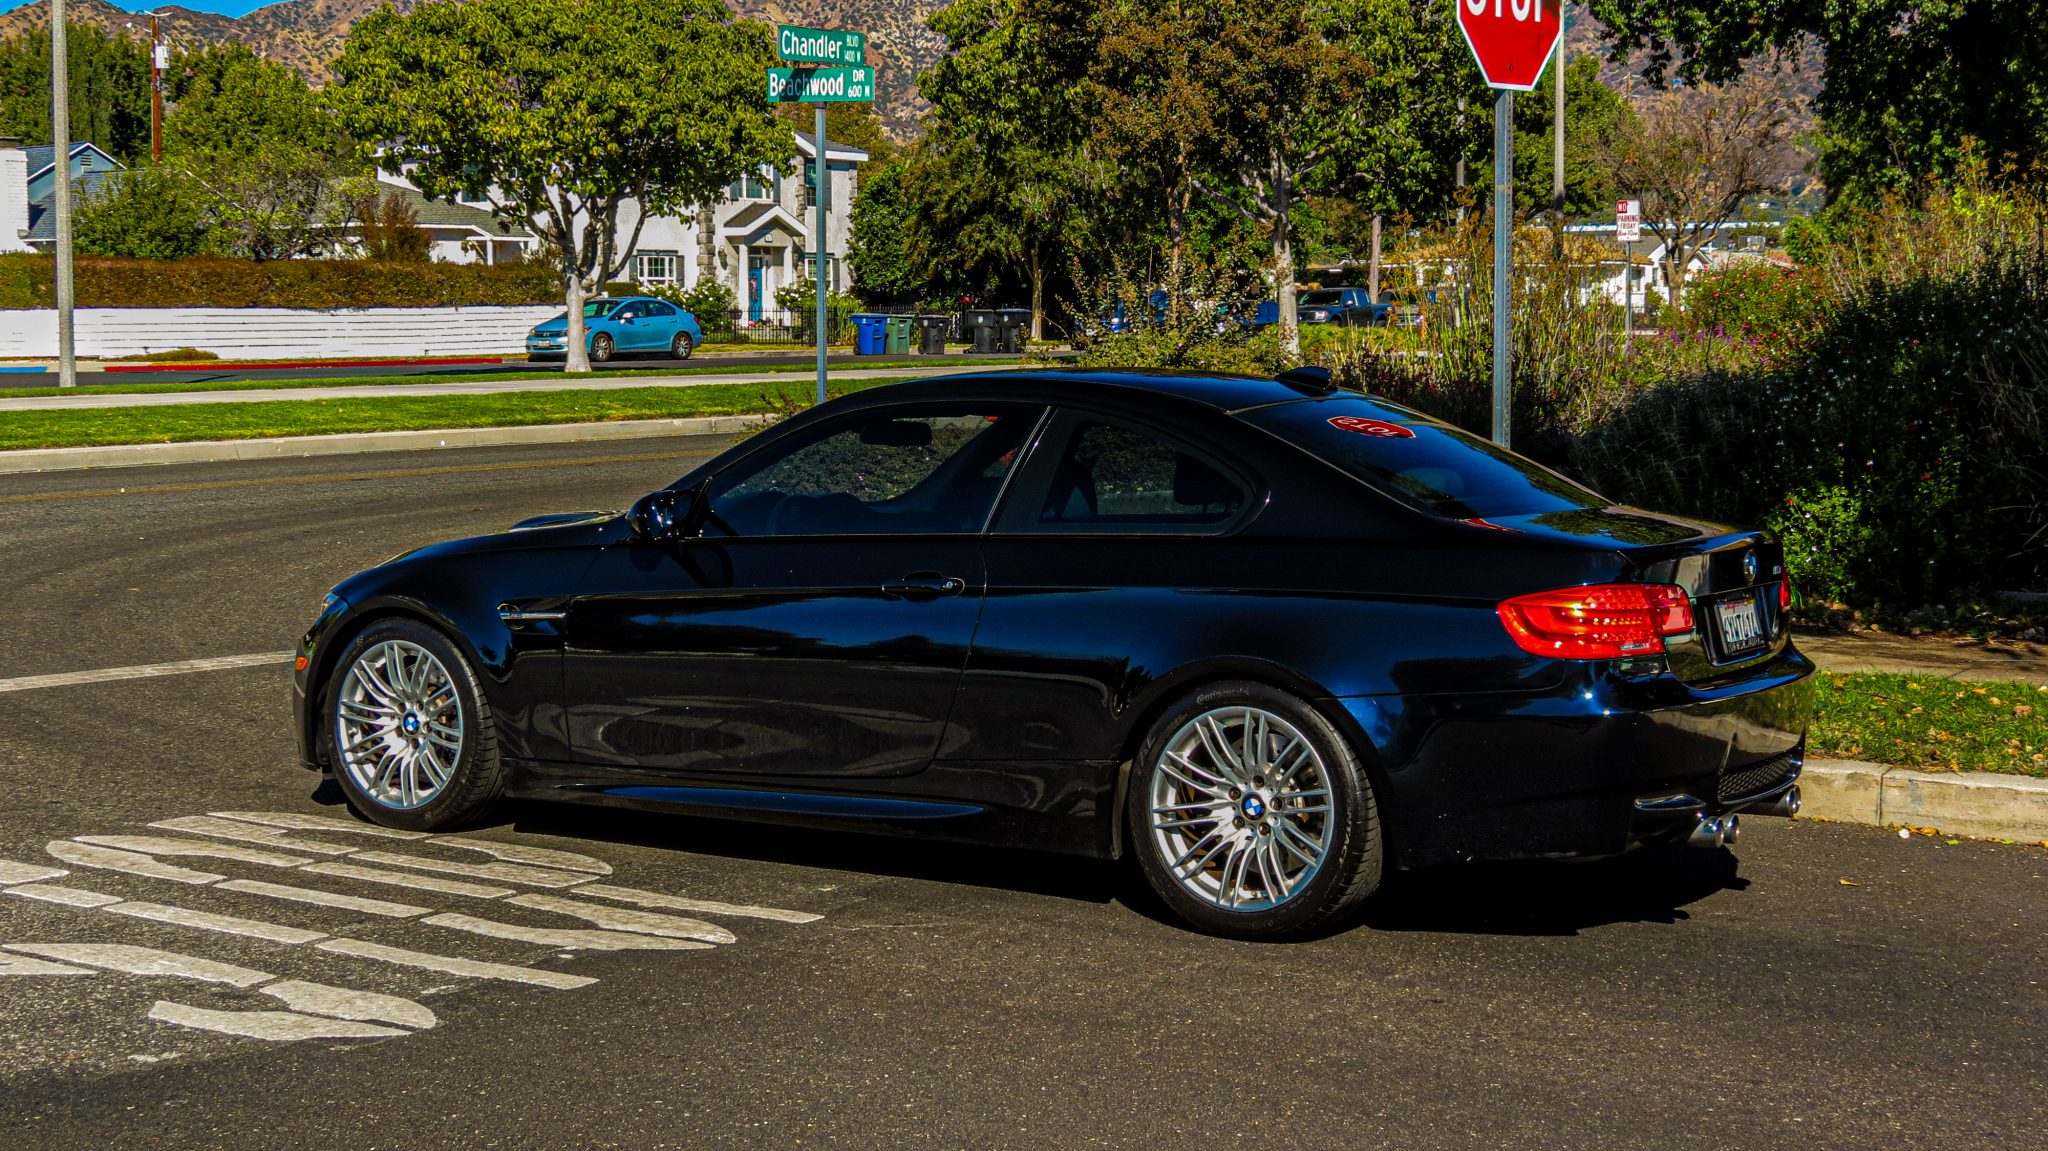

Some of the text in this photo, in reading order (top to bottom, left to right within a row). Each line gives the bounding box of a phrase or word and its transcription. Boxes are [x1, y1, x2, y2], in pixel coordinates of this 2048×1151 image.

[781, 30, 843, 59] Chandler
[852, 70, 865, 82] DR
[769, 73, 844, 97] Beachwood
[847, 85, 871, 97] 600 N
[1617, 203, 1627, 212] NO
